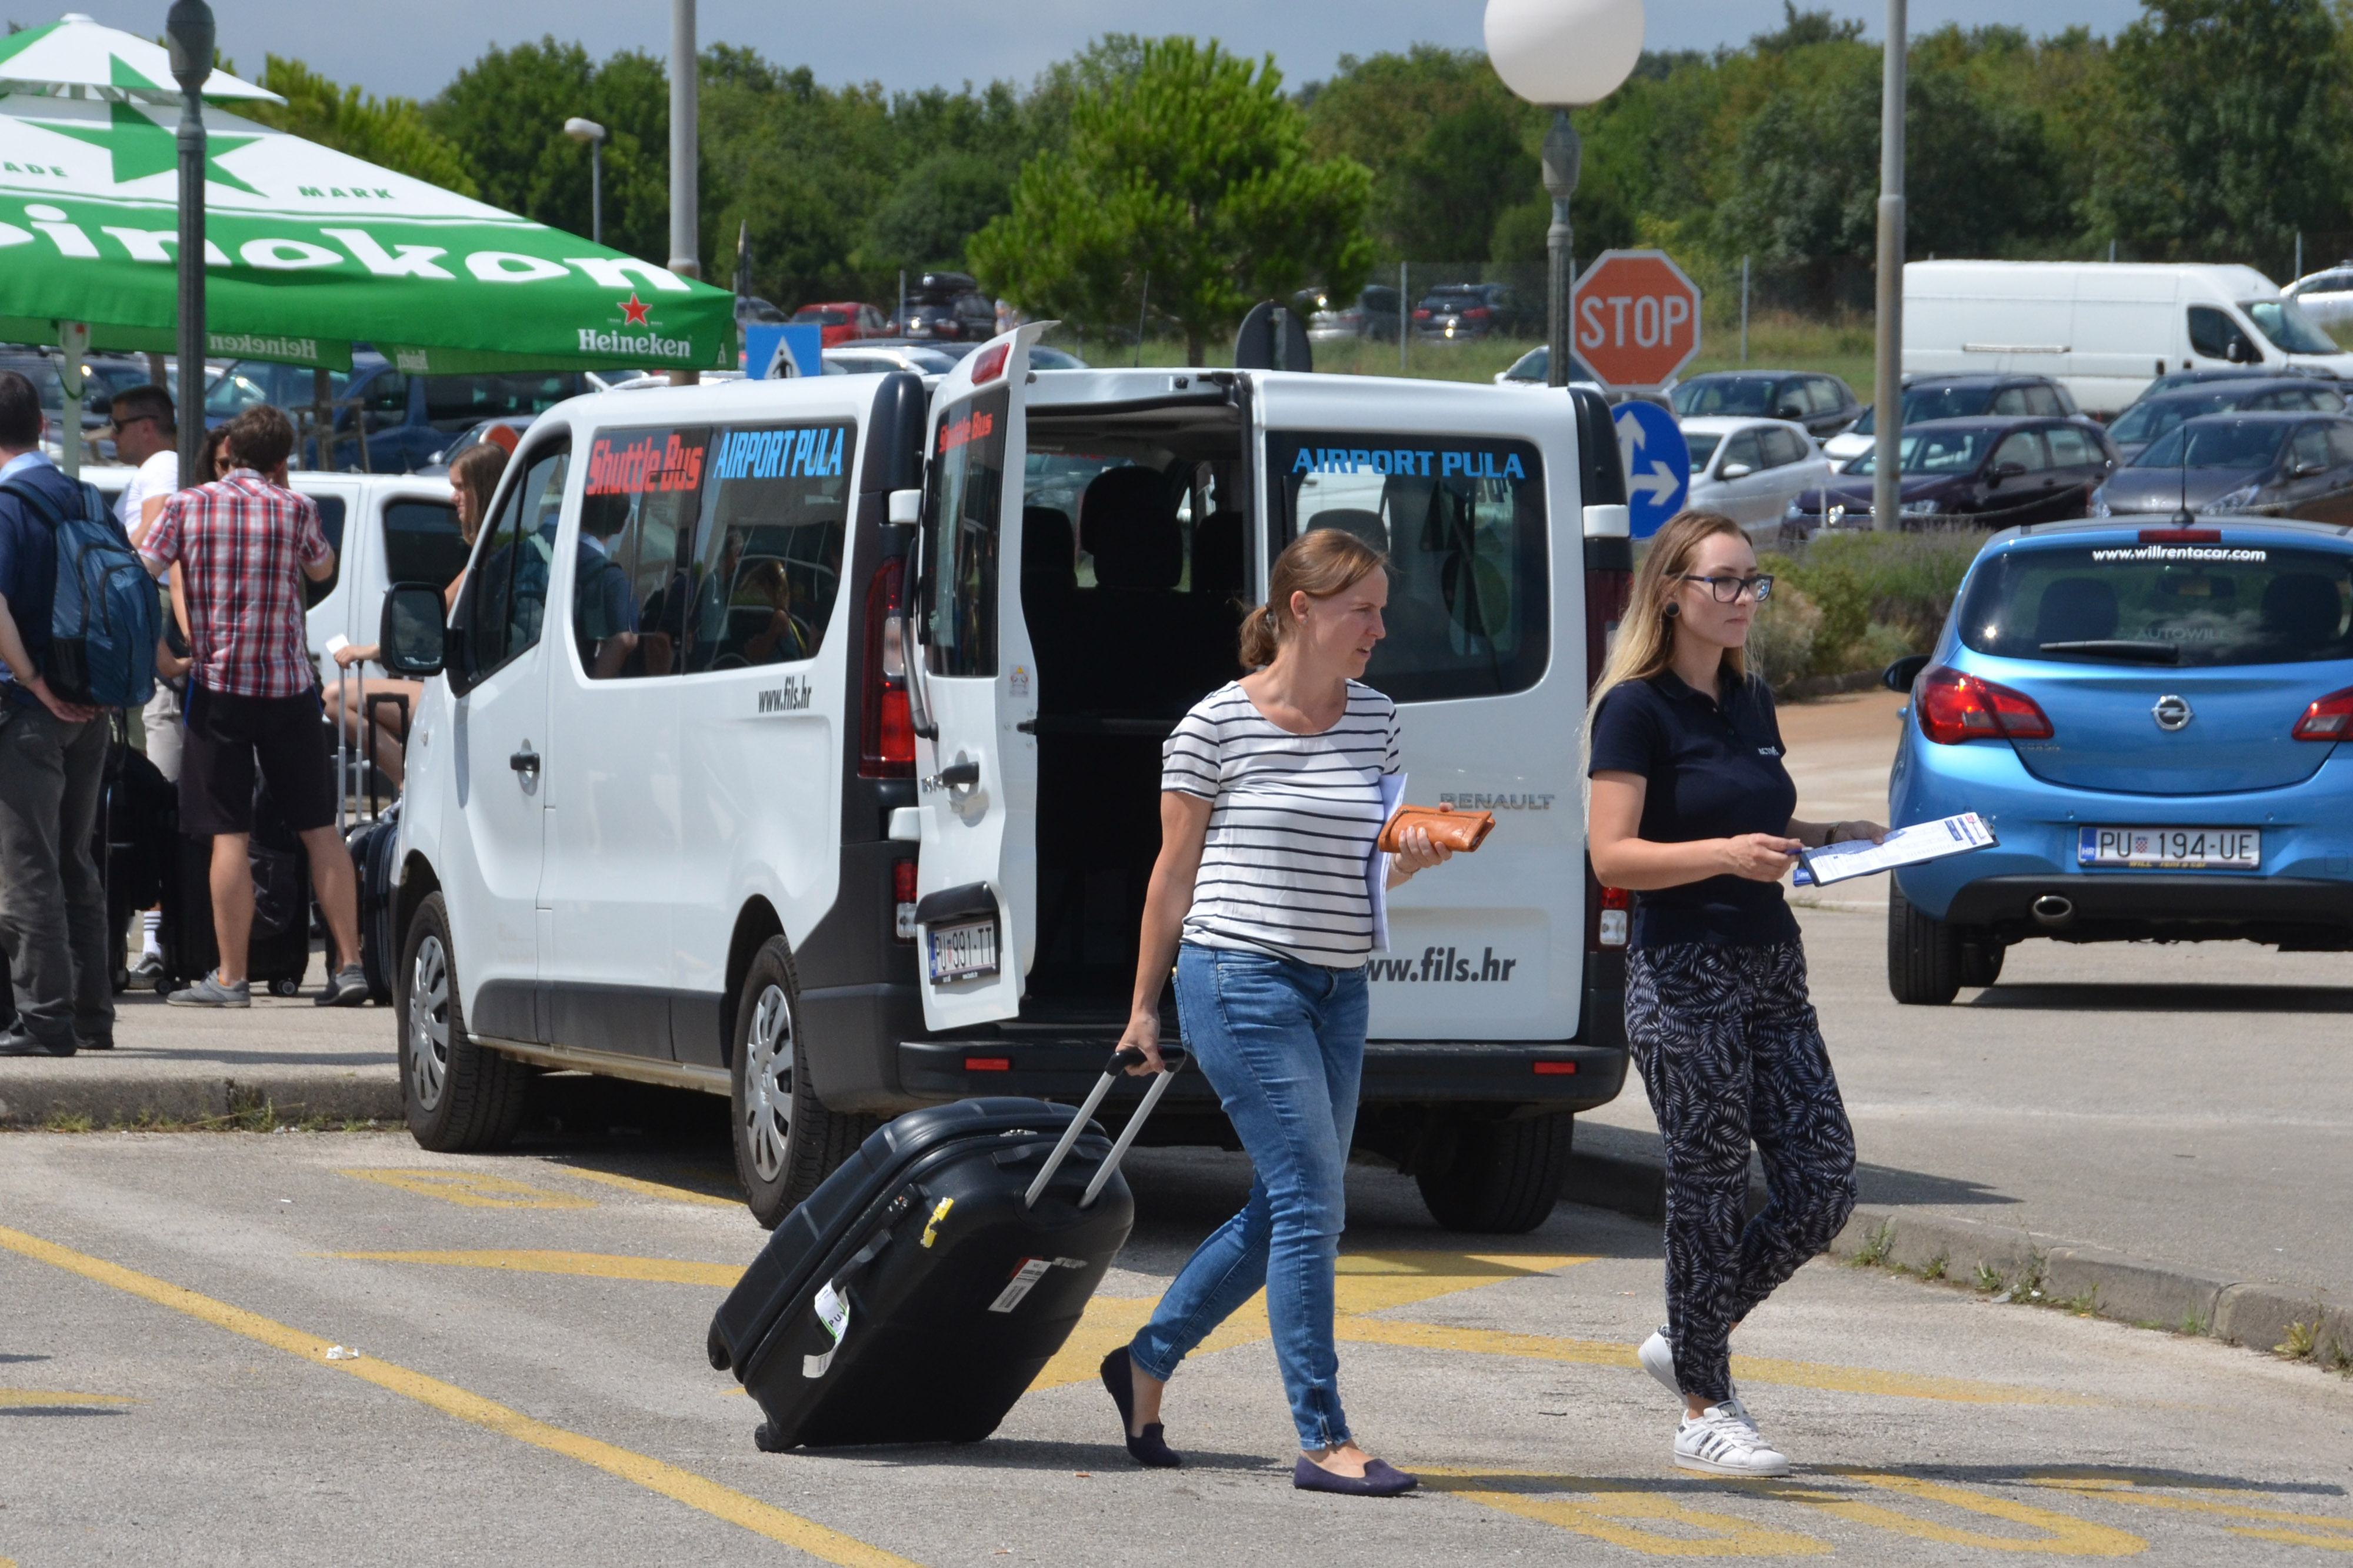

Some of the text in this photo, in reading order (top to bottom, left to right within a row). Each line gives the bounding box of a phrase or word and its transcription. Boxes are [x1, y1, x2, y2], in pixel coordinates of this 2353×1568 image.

[298, 185, 395, 199] MARK
[1581, 295, 1688, 348] STOP
[578, 329, 691, 358] Heineken
[971, 411, 993, 439] Bus
[585, 434, 704, 495] Shuttle Bus
[713, 428, 844, 478] AIRPORT PULA
[1292, 448, 1525, 479] AIRPORT PULA
[2092, 545, 2267, 562] www.willrentacar.com
[758, 675, 812, 713] www.fils.hr
[1439, 793, 1555, 810] RENAULT
[2082, 847, 2095, 856] HR
[2100, 831, 2253, 860] PU 194-UE
[935, 935, 946, 972] PU
[1367, 946, 1517, 982] ww.fils.hr
